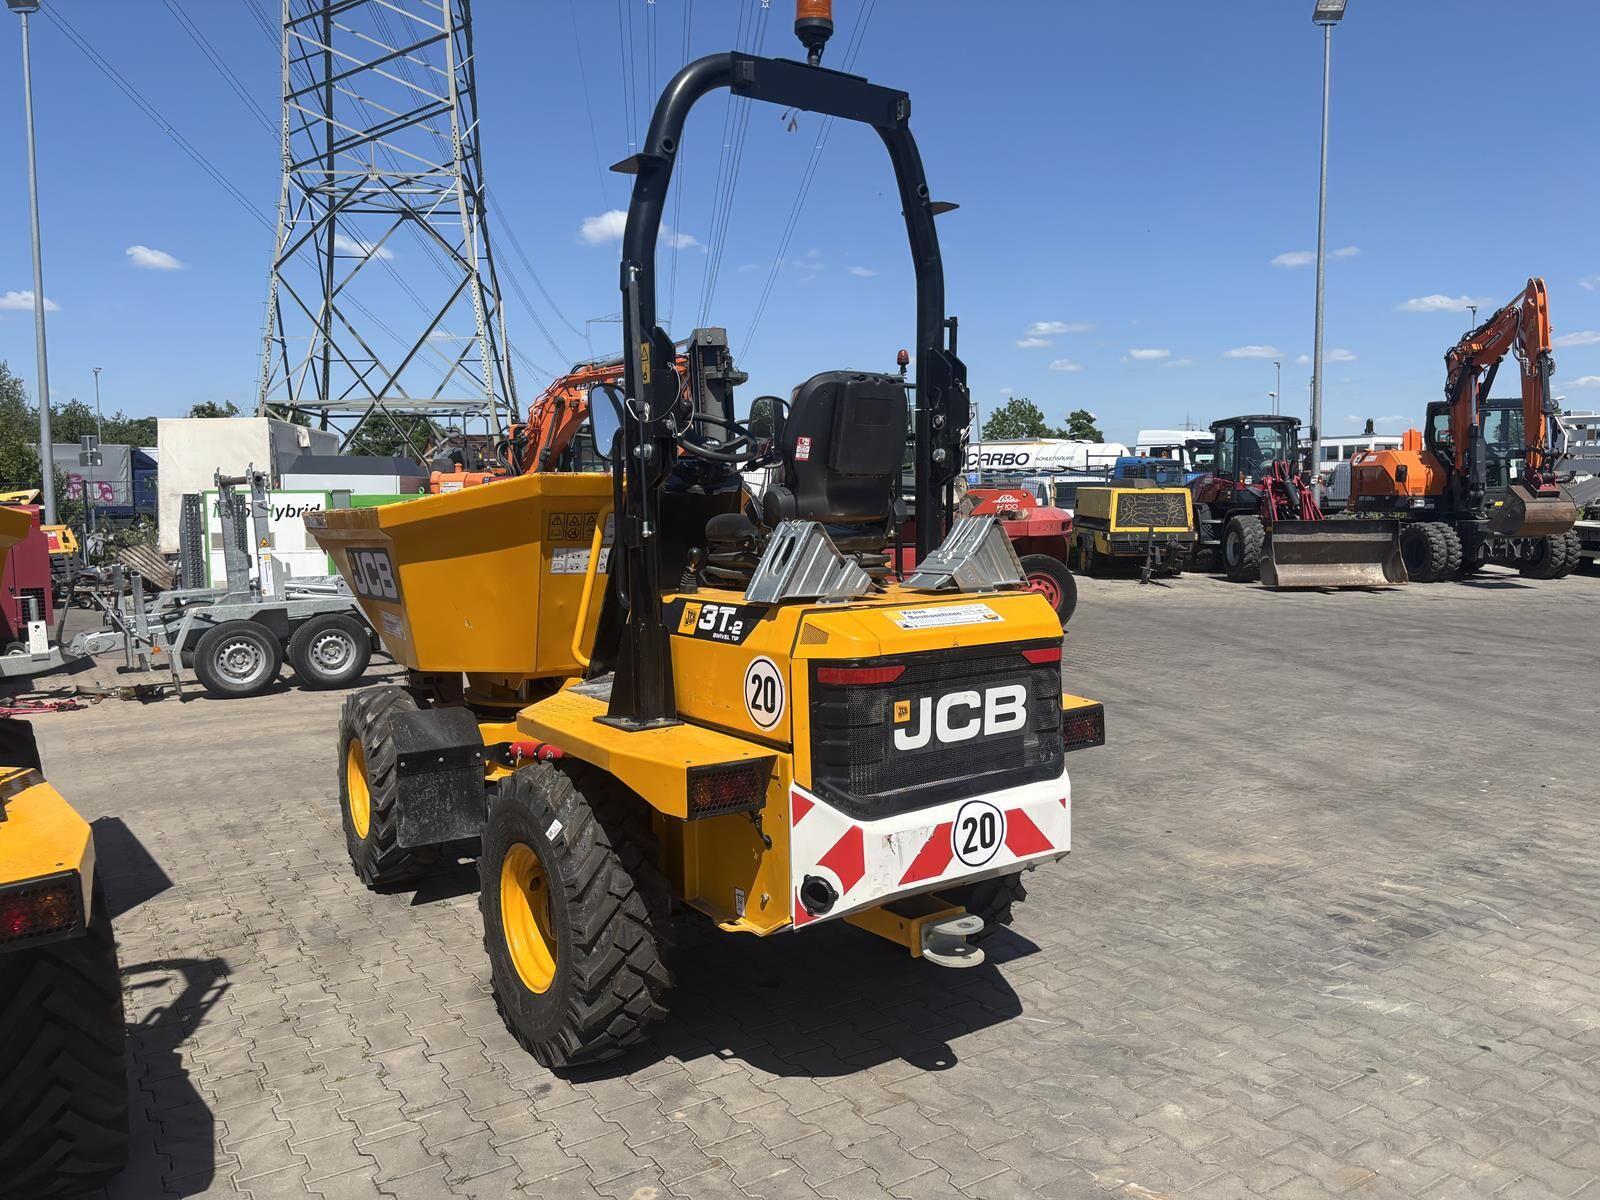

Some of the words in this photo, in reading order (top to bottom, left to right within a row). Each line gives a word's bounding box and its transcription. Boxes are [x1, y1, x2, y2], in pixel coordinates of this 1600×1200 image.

[968, 453, 1030, 466] CARBO
[348, 552, 398, 599] JCB
[751, 674, 776, 714] 20
[893, 684, 1027, 751] JCB
[962, 812, 996, 855] 20
